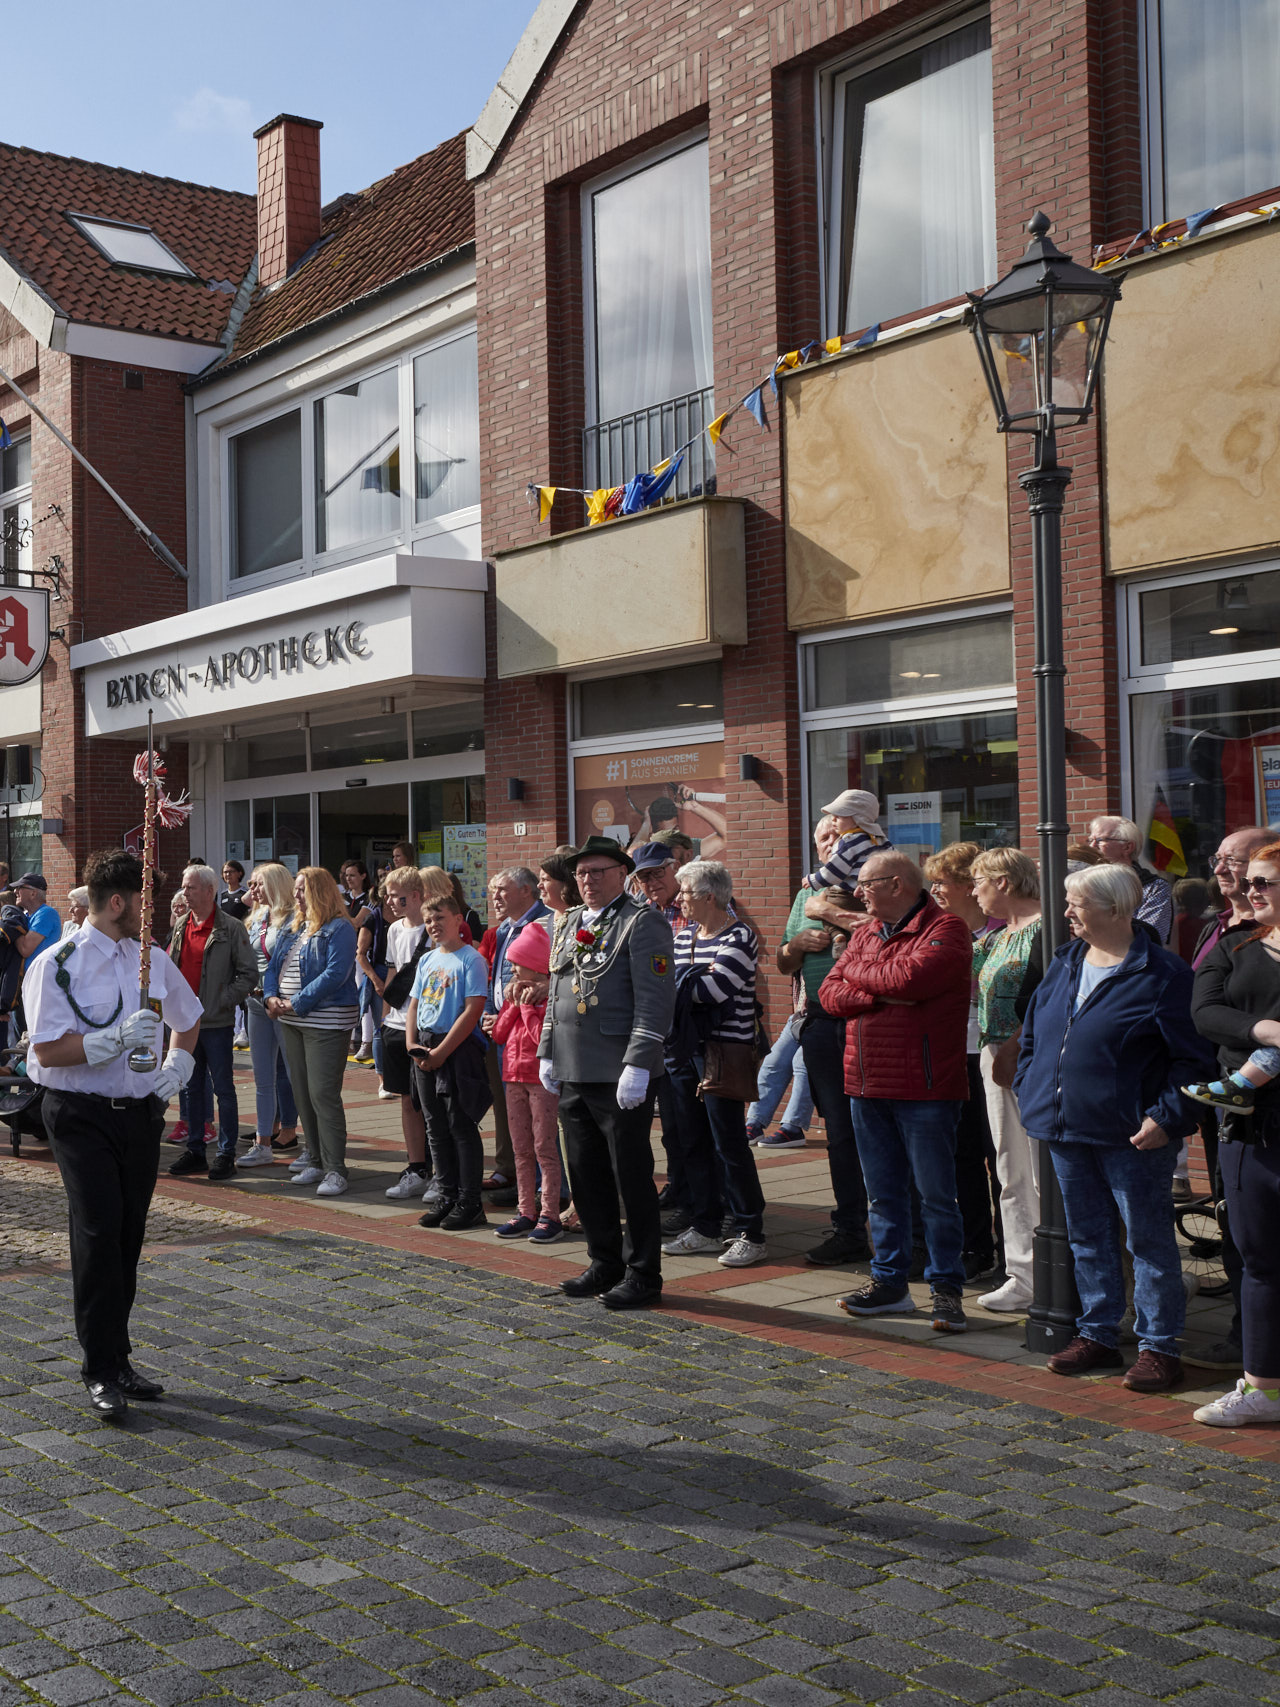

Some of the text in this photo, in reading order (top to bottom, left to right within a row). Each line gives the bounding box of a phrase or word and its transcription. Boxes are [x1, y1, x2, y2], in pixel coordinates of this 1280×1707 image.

[106, 620, 367, 708] BÄREN-APOTHEKE
[606, 752, 699, 781] #1 SONNENCREME
[631, 768, 651, 779] AUS
[910, 801, 932, 810] ISDIN
[516, 824, 524, 834] 17
[457, 830, 477, 839] Guten
